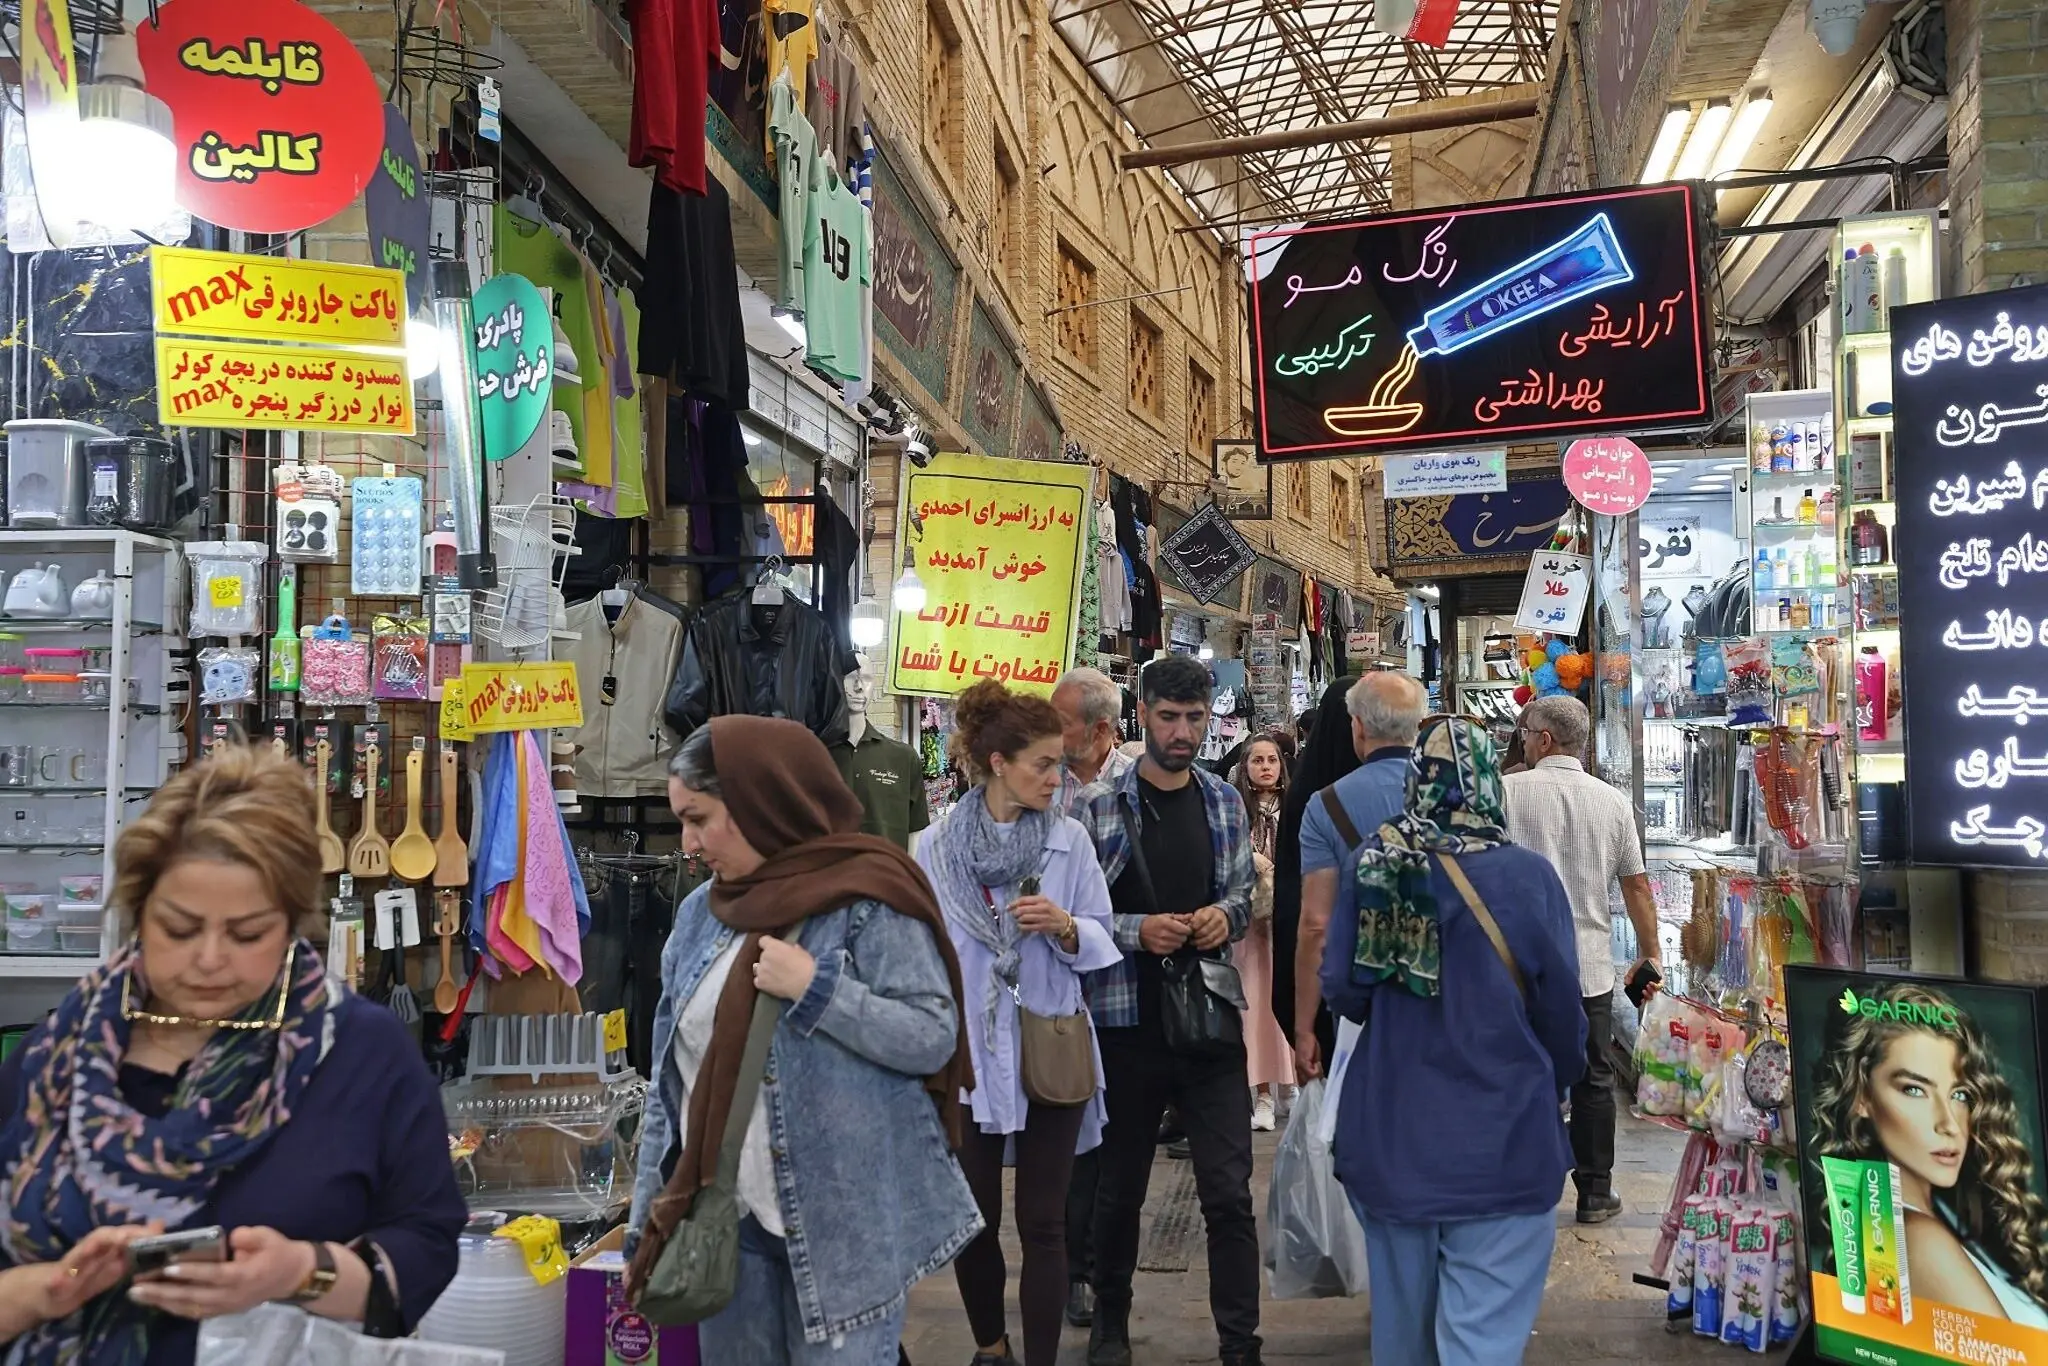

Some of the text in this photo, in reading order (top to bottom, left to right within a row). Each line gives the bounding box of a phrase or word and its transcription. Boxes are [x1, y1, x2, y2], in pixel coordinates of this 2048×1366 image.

[184, 41, 321, 92] قابلمه
[192, 133, 320, 180] کالین
[382, 148, 416, 198] قابلمه
[382, 236, 416, 275] عروس
[1284, 215, 1458, 309] رنگ مو
[167, 265, 254, 323] max
[350, 289, 398, 332] پاکت
[1481, 273, 1558, 318] OKEEA
[1559, 290, 1684, 357] آرایشی
[1275, 314, 1376, 376] ترکیبی
[1902, 322, 1962, 376] های
[171, 351, 401, 390] مسدود کننده دریچه کولر
[503, 349, 548, 399] فرش
[172, 376, 234, 414] max
[232, 391, 289, 420] پنجره
[368, 395, 401, 424] نوار
[1441, 459, 1460, 469] موی
[1461, 455, 1481, 467] رنگ
[1582, 442, 1634, 463] جوان سازی
[1448, 474, 1468, 483] موهای
[1470, 472, 1497, 481] مخصوص
[1582, 464, 1635, 486] و آبرسانی
[1929, 460, 2027, 517] شیرین
[919, 497, 971, 521] احمدی
[1582, 490, 1636, 508] پوست و مو
[1058, 509, 1074, 532] به
[928, 546, 1047, 583] خوش آمدید
[1639, 525, 1692, 569] نقره
[1542, 559, 1582, 577] خرید
[1543, 580, 1570, 597] طلا
[974, 605, 1051, 638] قیمت
[1535, 607, 1566, 625] نقره
[901, 642, 1060, 685] قضاوت با شما
[1349, 643, 1375, 654] وحید
[469, 672, 507, 724] max
[551, 677, 577, 712] پاکت
[1859, 997, 1957, 1028] GARNIC
[1866, 1168, 1885, 1247] GARNIC
[1840, 1208, 1861, 1292] GARNIC
[1932, 1307, 1978, 1329] HERBAL
[1933, 1318, 1973, 1337] COLOR
[1934, 1328, 2028, 1364] NO AMMONIA
[1935, 1340, 1956, 1355] NO
